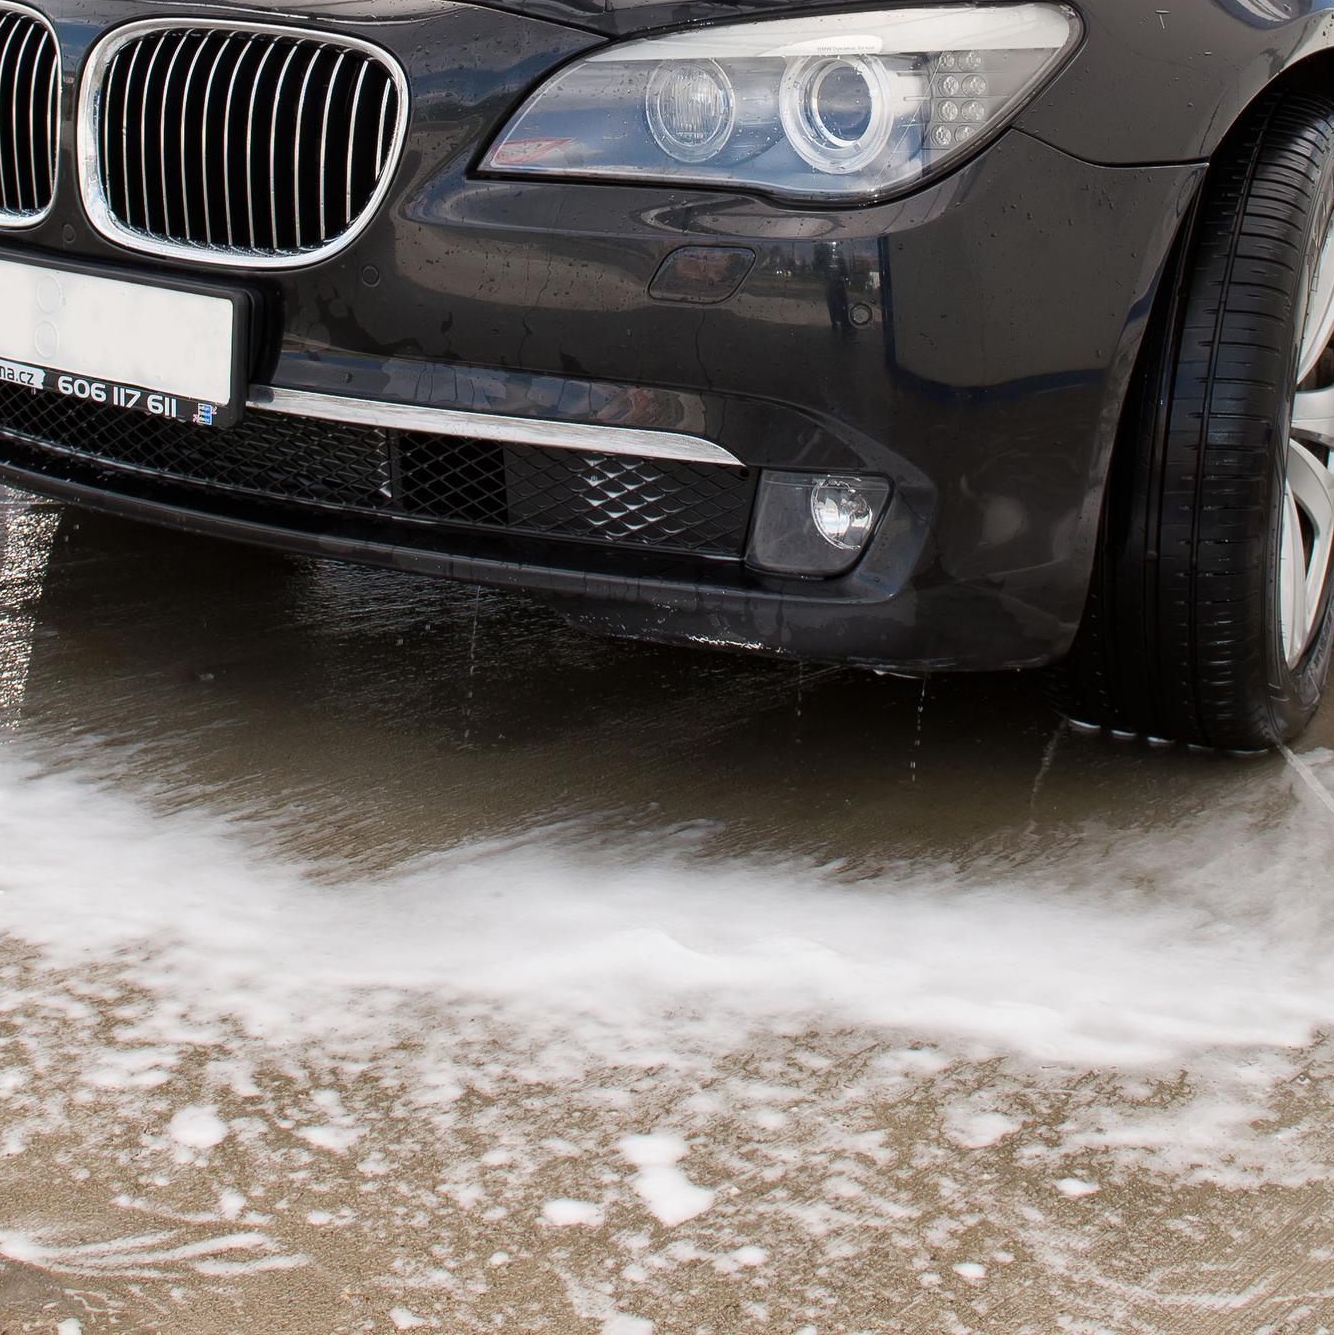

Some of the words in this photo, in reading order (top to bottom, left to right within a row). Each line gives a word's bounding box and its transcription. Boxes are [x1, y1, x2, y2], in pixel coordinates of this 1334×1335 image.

[57, 375, 107, 402] 606
[113, 386, 141, 408] 117
[147, 394, 177, 417] 611
